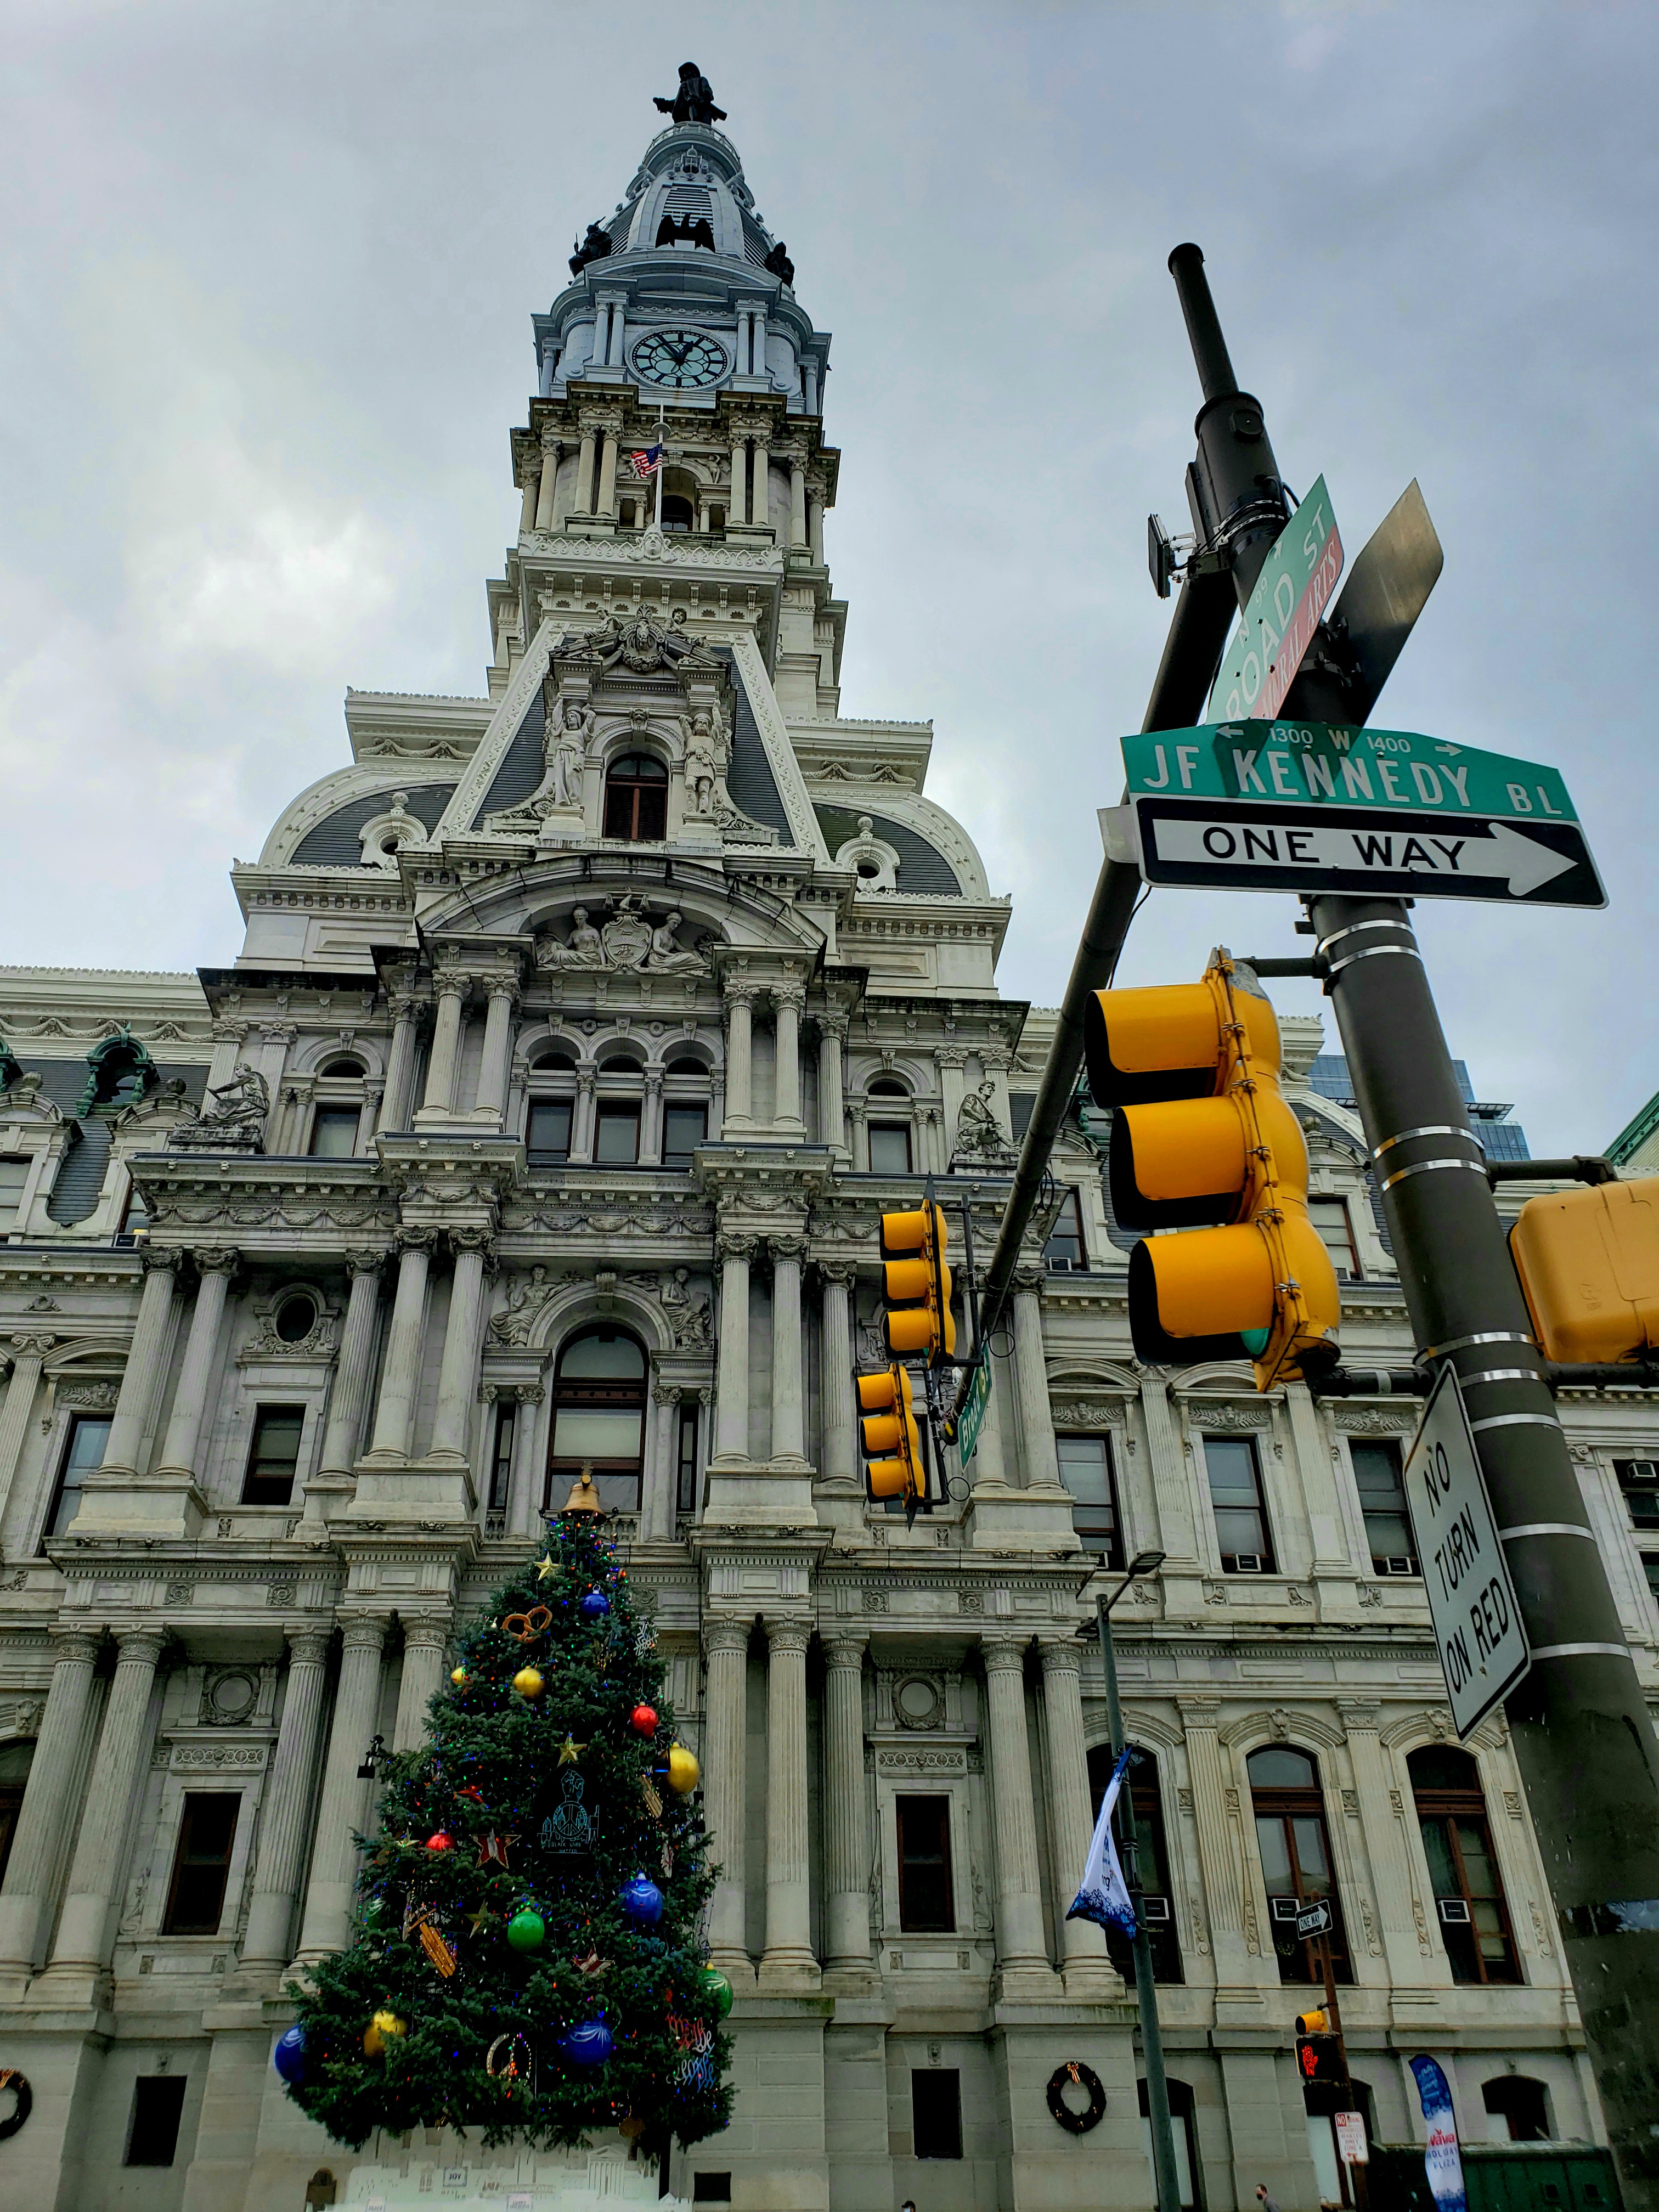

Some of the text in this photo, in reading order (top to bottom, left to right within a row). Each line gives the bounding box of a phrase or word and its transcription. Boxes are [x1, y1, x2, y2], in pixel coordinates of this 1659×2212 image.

[1304, 503, 1325, 571] ST
[1307, 539, 1338, 635] ARTS
[1237, 617, 1250, 649] N
[1269, 727, 1411, 753] 1300 W 1400
[1143, 745, 1562, 815] JF KENNEDY BL
[1203, 826, 1466, 870] ONE WAY
[962, 1378, 981, 1452] Broad
[1424, 1441, 1451, 1519] NO
[1435, 1502, 1480, 1602] TURN
[1446, 1576, 1510, 1695] ON RED
[1300, 1912, 1321, 1929] ONE WAY
[1336, 2115, 1346, 2125] NO
